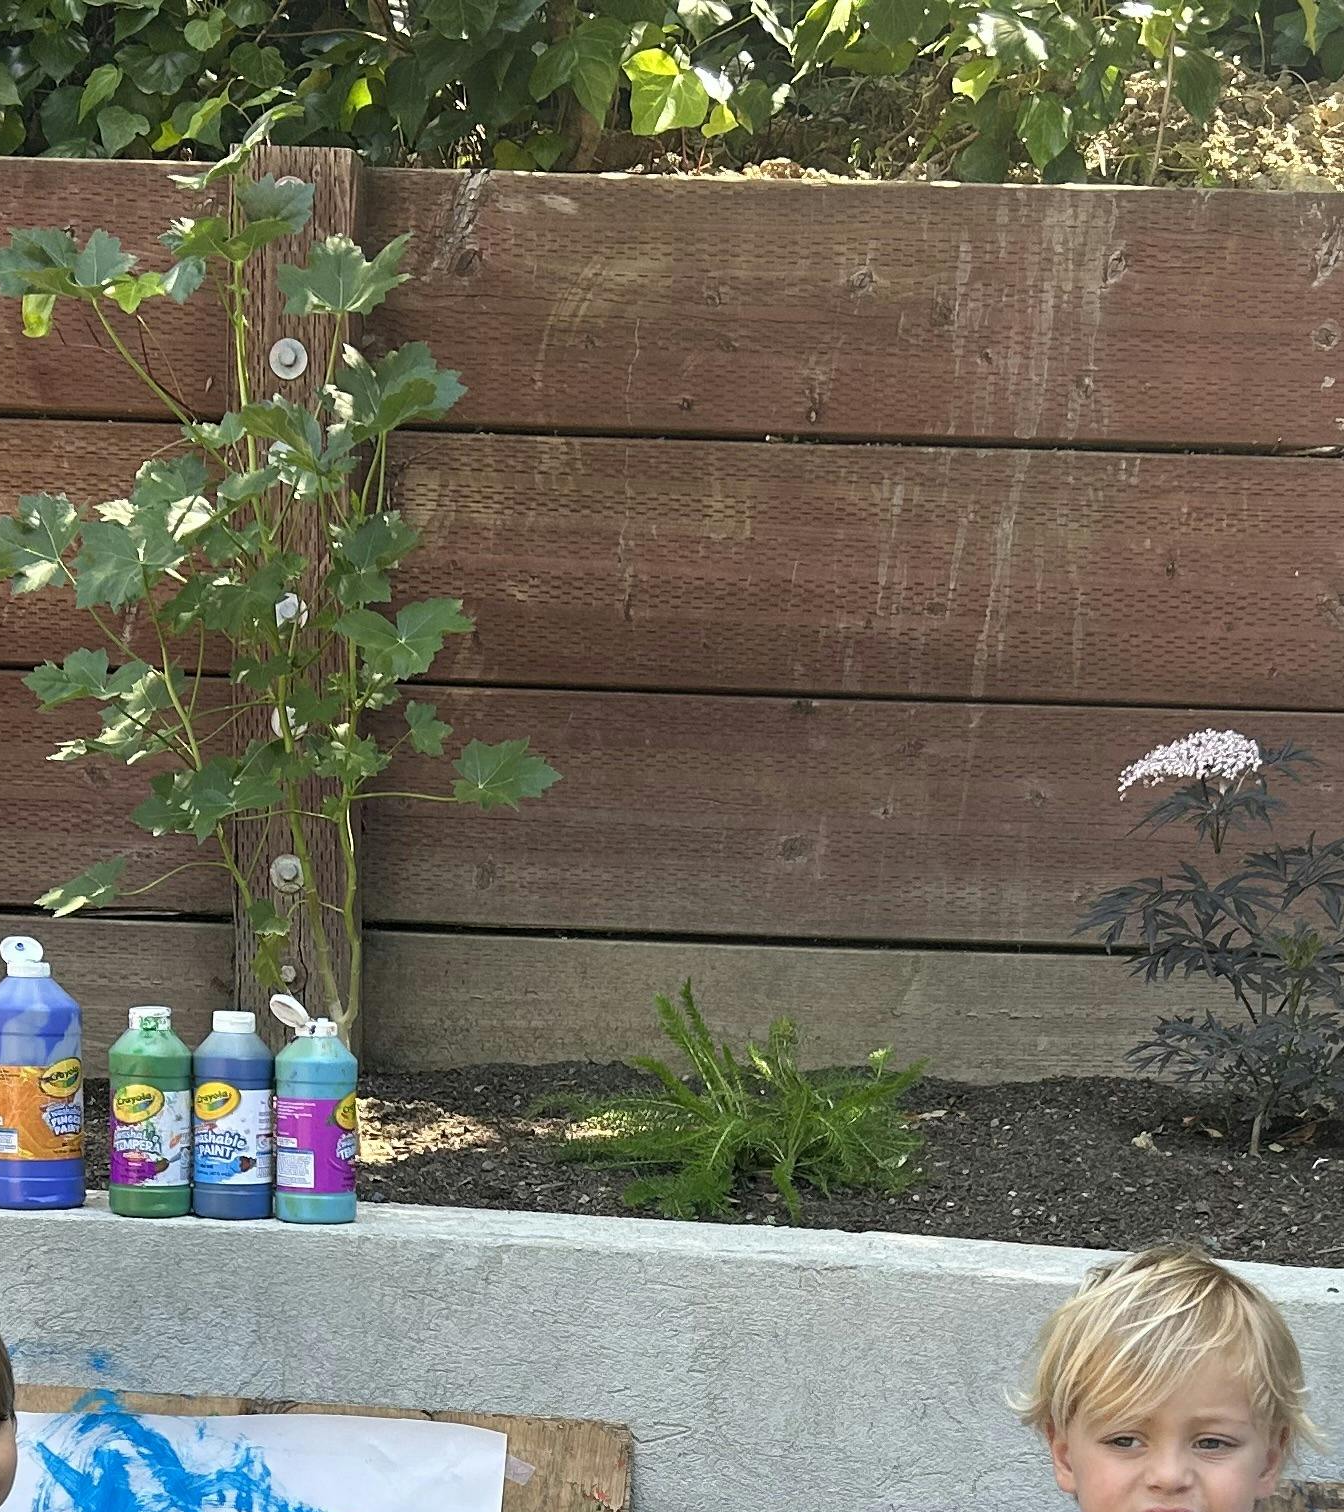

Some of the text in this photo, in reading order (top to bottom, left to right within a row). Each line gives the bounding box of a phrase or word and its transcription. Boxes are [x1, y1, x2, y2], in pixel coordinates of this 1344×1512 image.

[117, 1093, 153, 1106] Crayola
[197, 1090, 228, 1104] Crayola
[198, 1144, 234, 1159] PAINT
